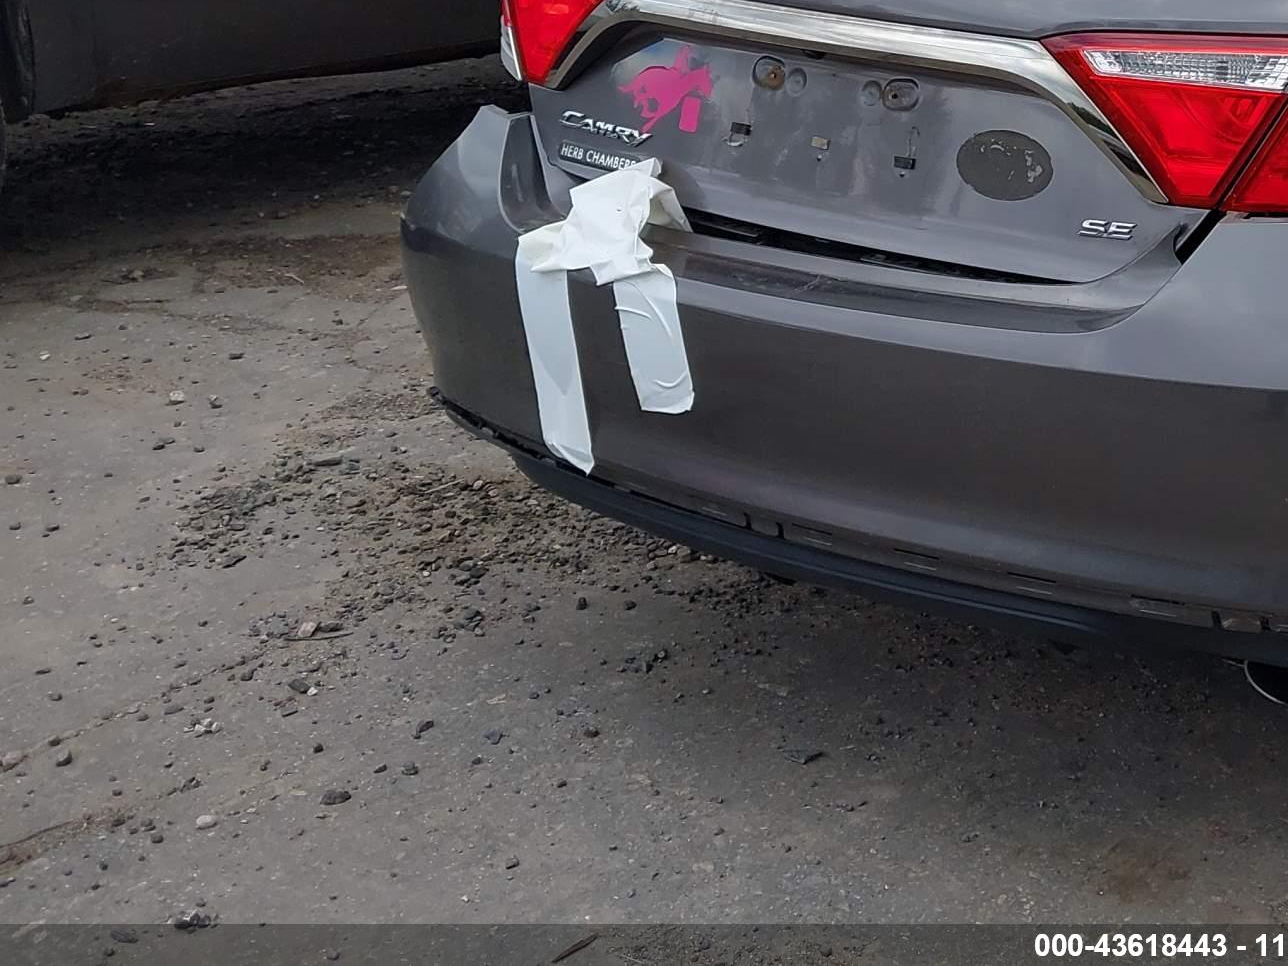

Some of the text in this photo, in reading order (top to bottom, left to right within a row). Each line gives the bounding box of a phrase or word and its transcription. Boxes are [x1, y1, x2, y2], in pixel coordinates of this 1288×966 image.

[559, 110, 653, 147] CAMRY
[560, 143, 584, 160] HERB
[1077, 219, 1137, 240] SE
